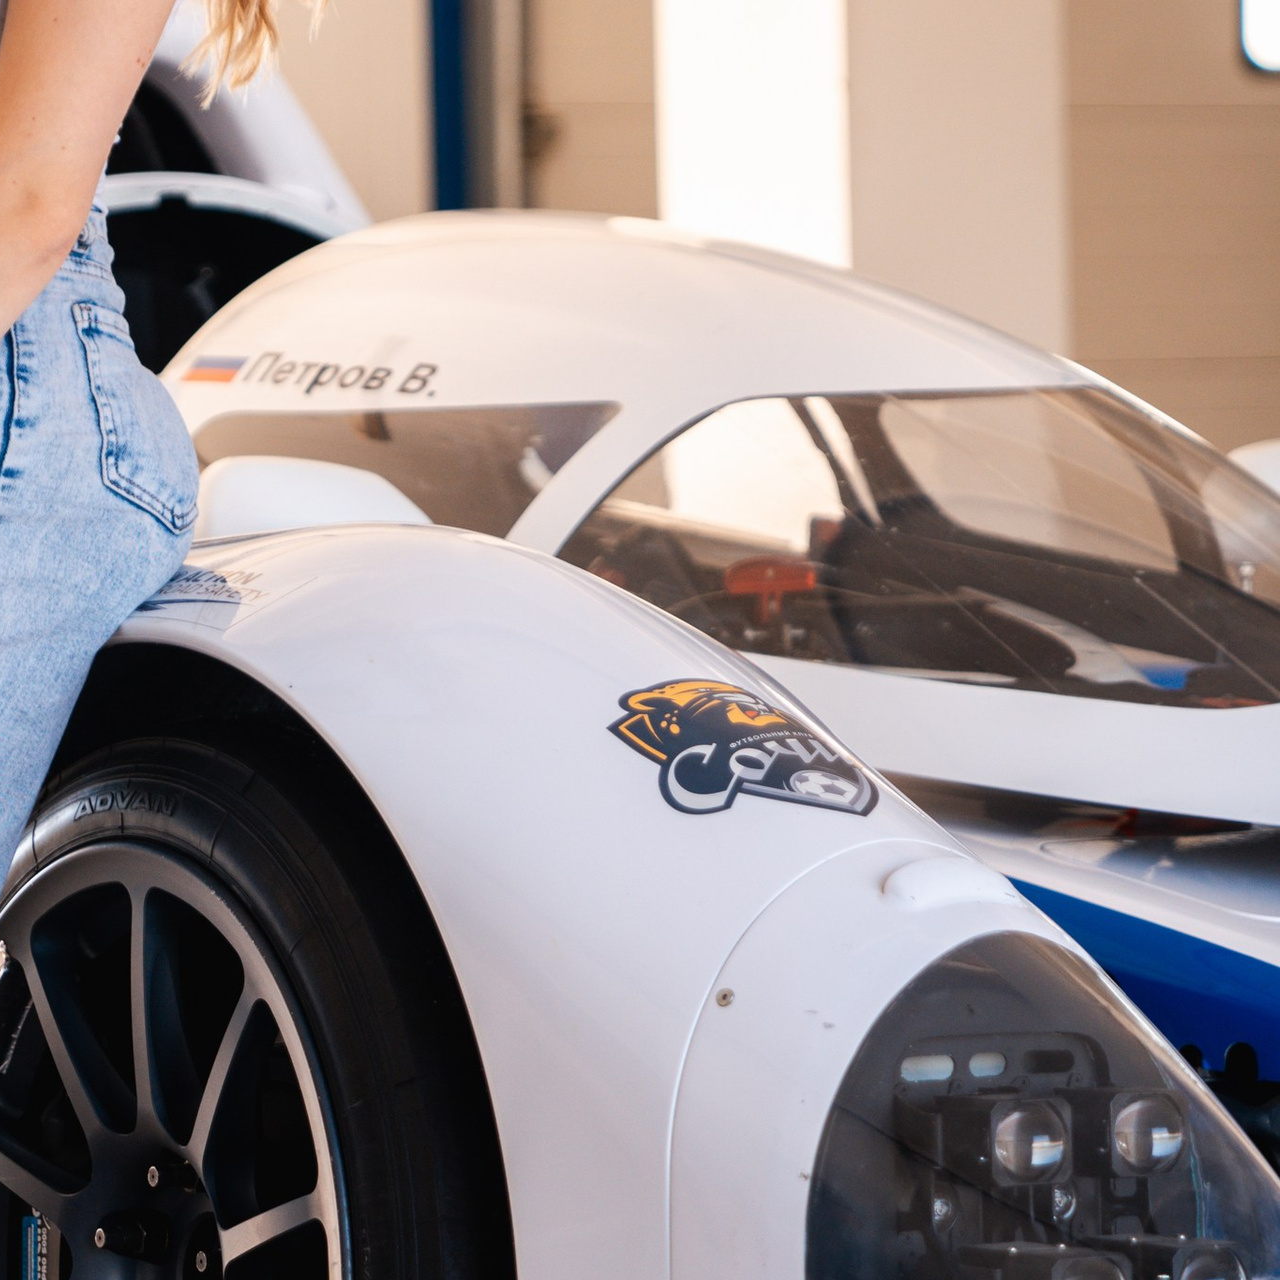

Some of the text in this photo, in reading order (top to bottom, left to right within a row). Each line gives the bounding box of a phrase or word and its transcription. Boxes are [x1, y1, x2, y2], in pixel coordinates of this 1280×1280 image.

[242, 351, 440, 397] Петров В.
[73, 790, 178, 821] ADVAN
